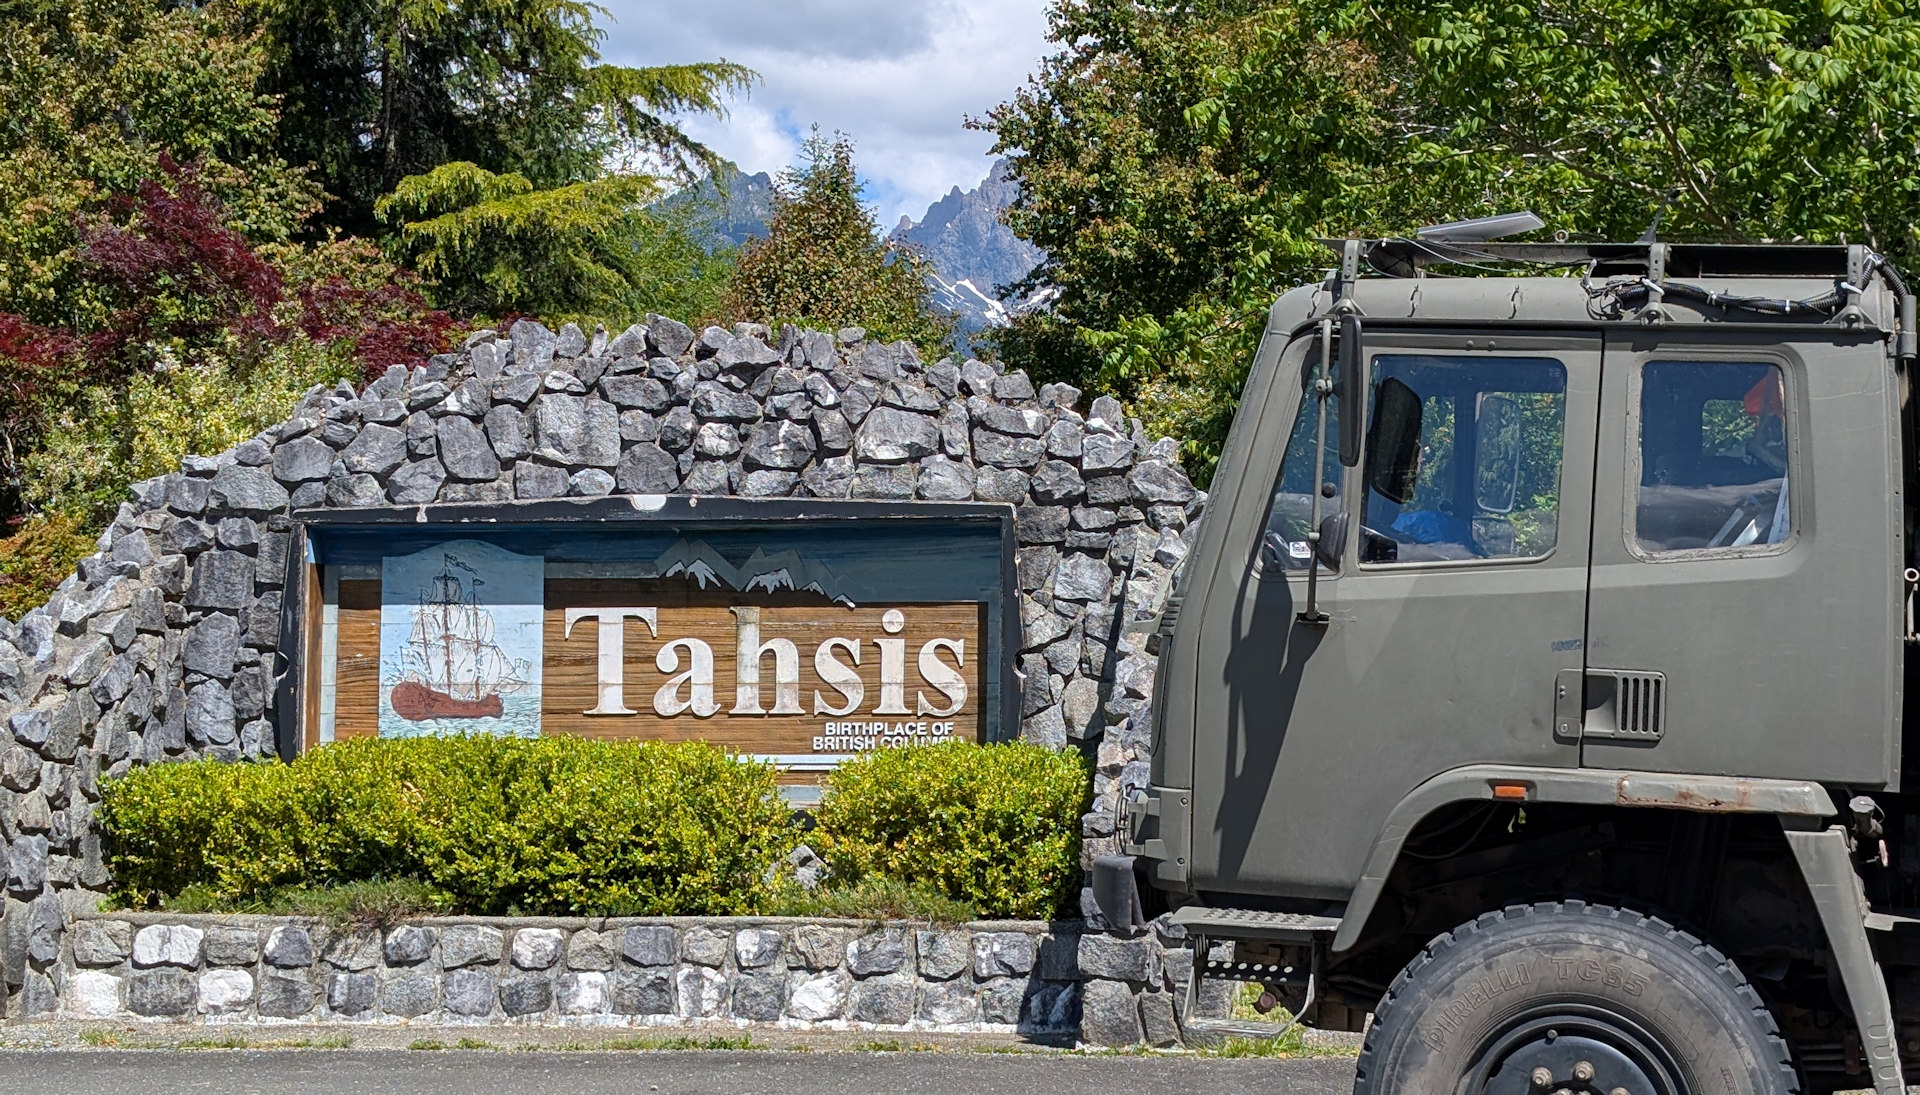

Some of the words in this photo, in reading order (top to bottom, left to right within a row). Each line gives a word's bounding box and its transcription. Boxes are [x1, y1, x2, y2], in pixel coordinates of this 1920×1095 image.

[565, 606, 969, 718] Tahsis
[812, 736, 876, 750] BRITISH
[825, 721, 927, 736] BIRTHPLACE
[931, 721, 955, 736] OF
[1423, 963, 1531, 1053] PIRELLI
